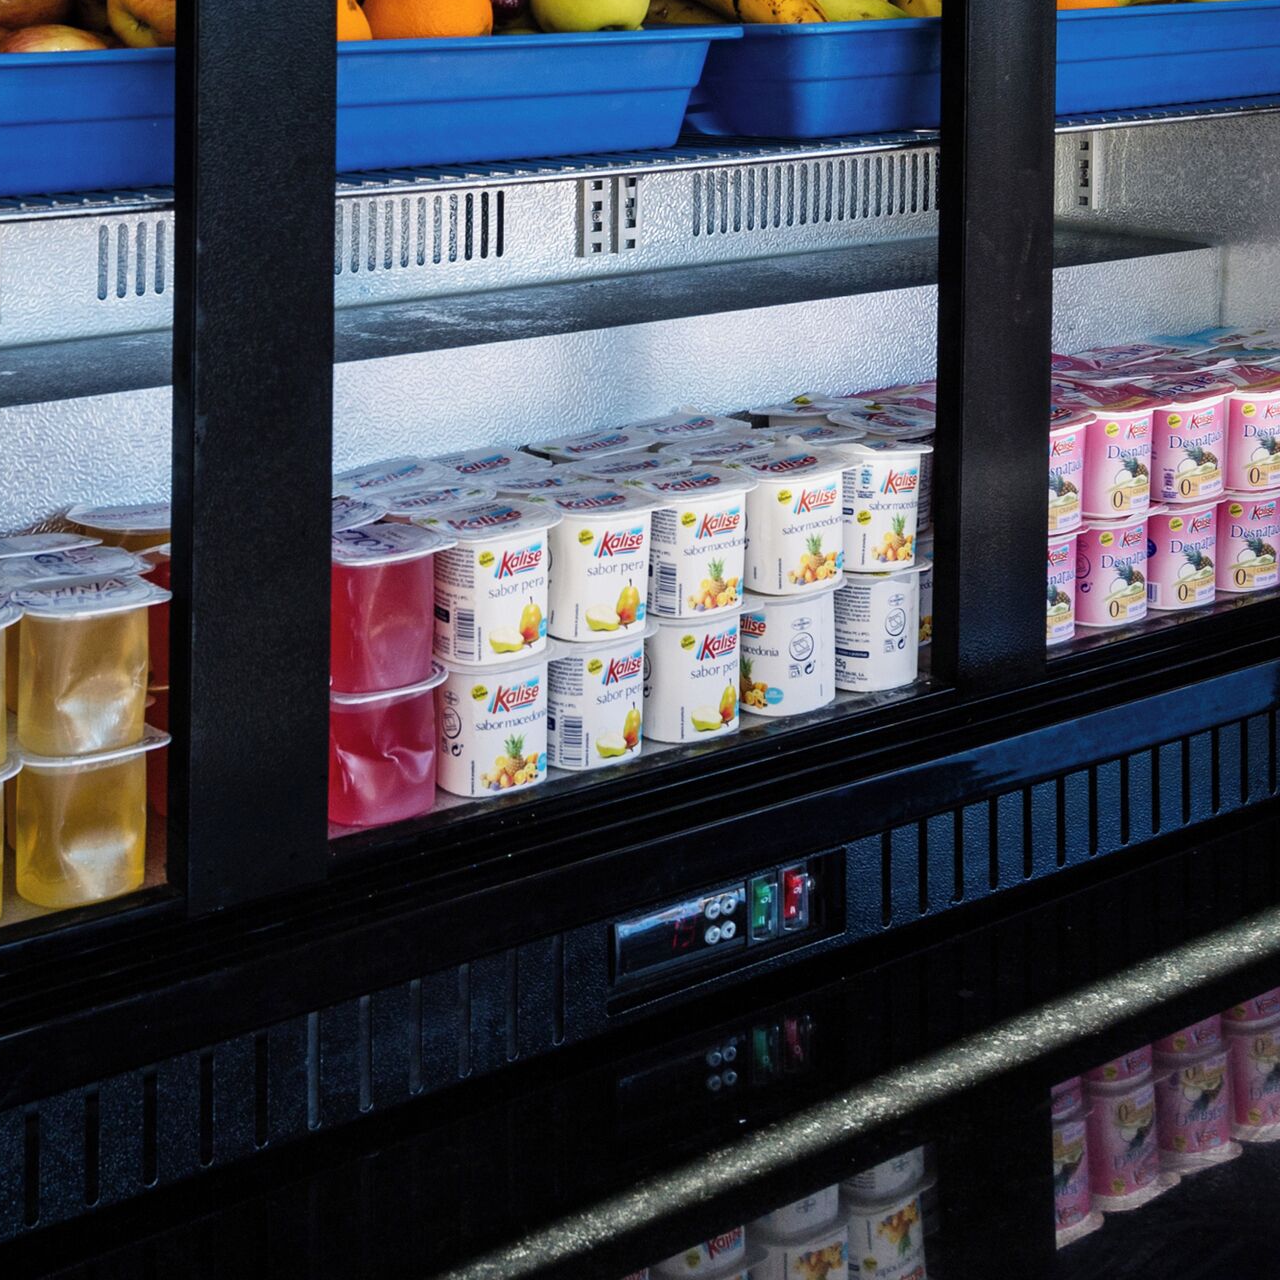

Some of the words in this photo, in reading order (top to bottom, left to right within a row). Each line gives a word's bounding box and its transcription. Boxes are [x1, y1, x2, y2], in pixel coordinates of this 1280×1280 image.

[884, 469, 918, 494] Kalise
[797, 489, 837, 515] Kalise
[869, 501, 891, 511] sabor
[699, 513, 740, 540] Kalise
[782, 523, 806, 536] sabor
[598, 531, 644, 558] Kalise
[683, 543, 706, 556] sabor
[499, 551, 542, 579] Kalise
[587, 563, 617, 576] sabor
[621, 560, 644, 575] pera
[488, 583, 518, 599] sabor
[521, 576, 544, 593] pera
[740, 614, 766, 633] alise
[740, 643, 779, 657] acedonia
[690, 665, 720, 680] sabor
[492, 685, 539, 714] Kalise
[596, 688, 623, 705] sabor
[626, 684, 642, 700] per
[475, 718, 503, 731] sabor
